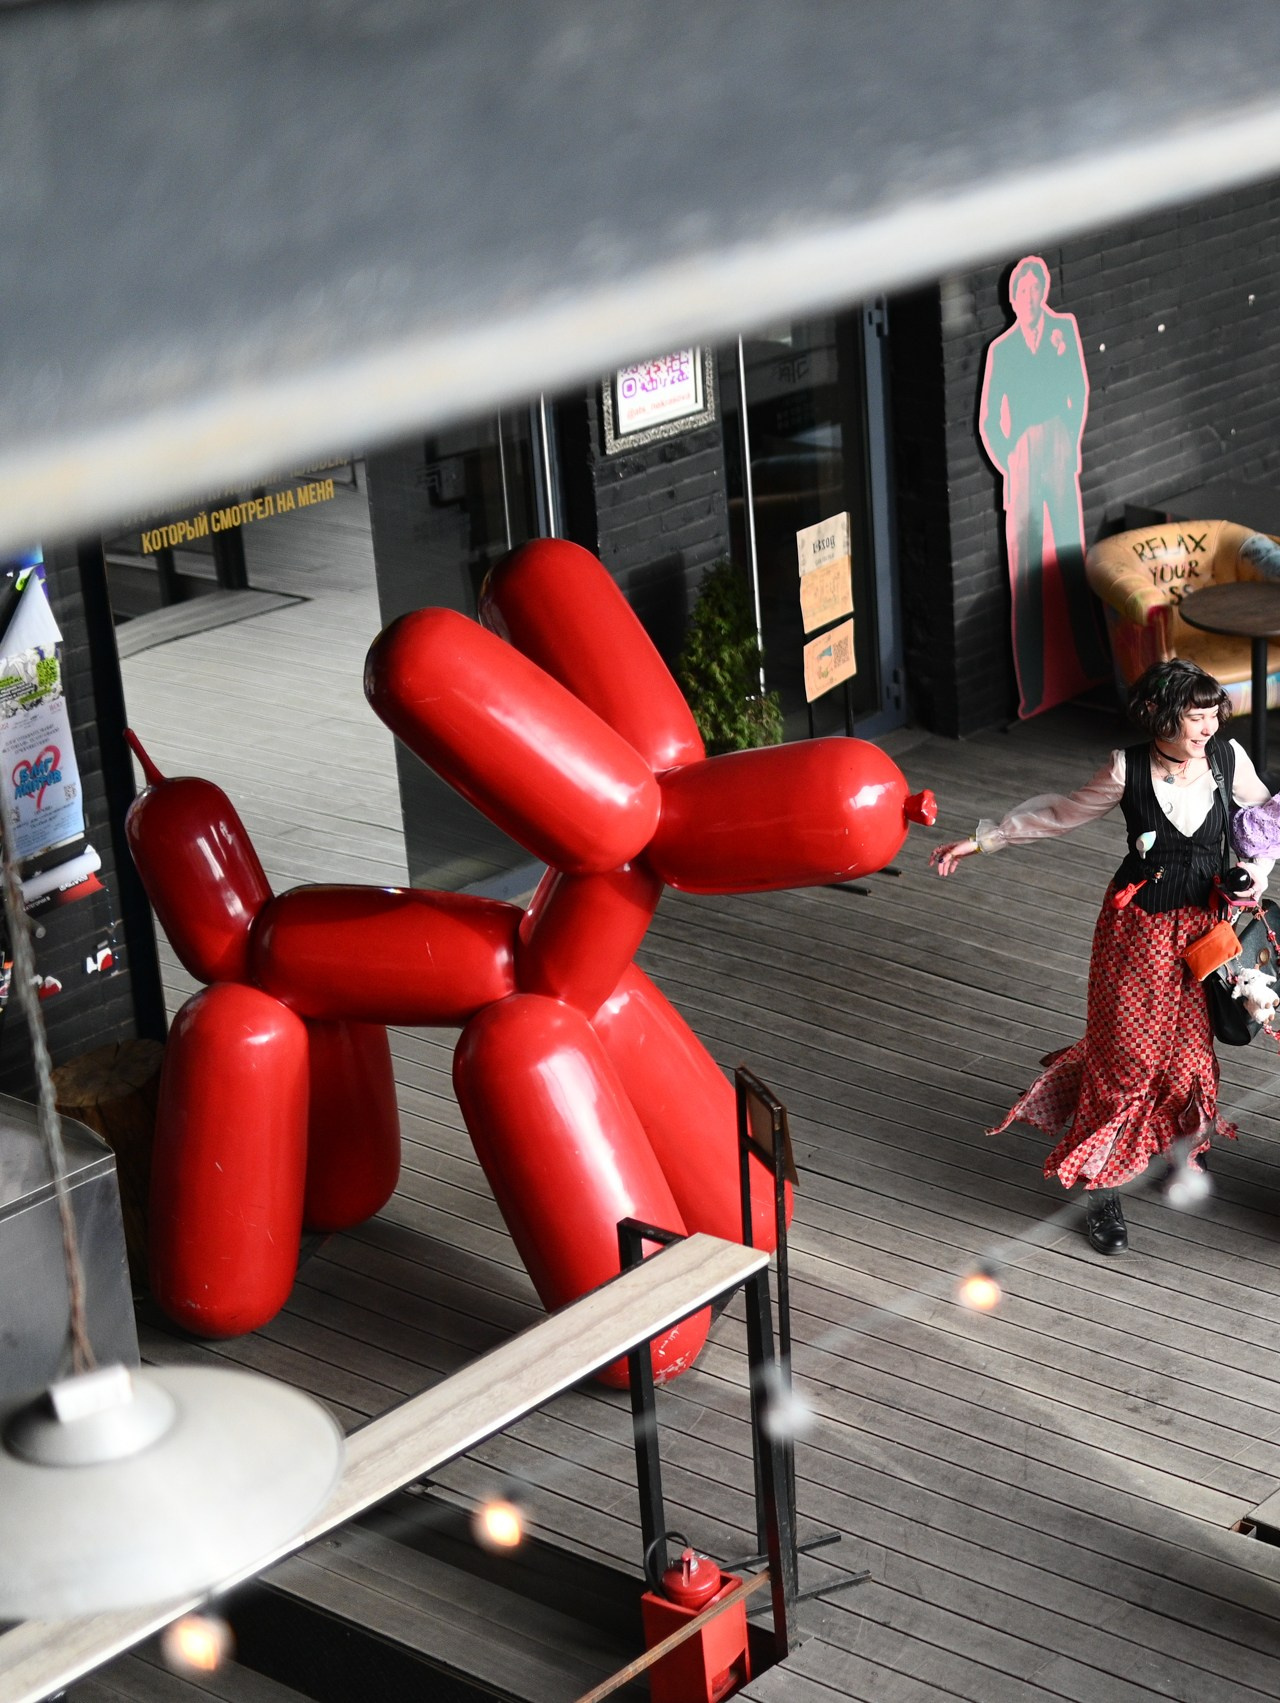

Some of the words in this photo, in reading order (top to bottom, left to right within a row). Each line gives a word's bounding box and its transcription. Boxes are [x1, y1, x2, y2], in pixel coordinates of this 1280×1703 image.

[141, 511, 209, 554] КОТОРЫЙ
[210, 498, 275, 533] СМОТРЕЛ
[276, 492, 295, 513] НА
[296, 478, 335, 509] МЕНЯ
[1132, 533, 1208, 562] RELAX
[1149, 560, 1200, 586] YOUR
